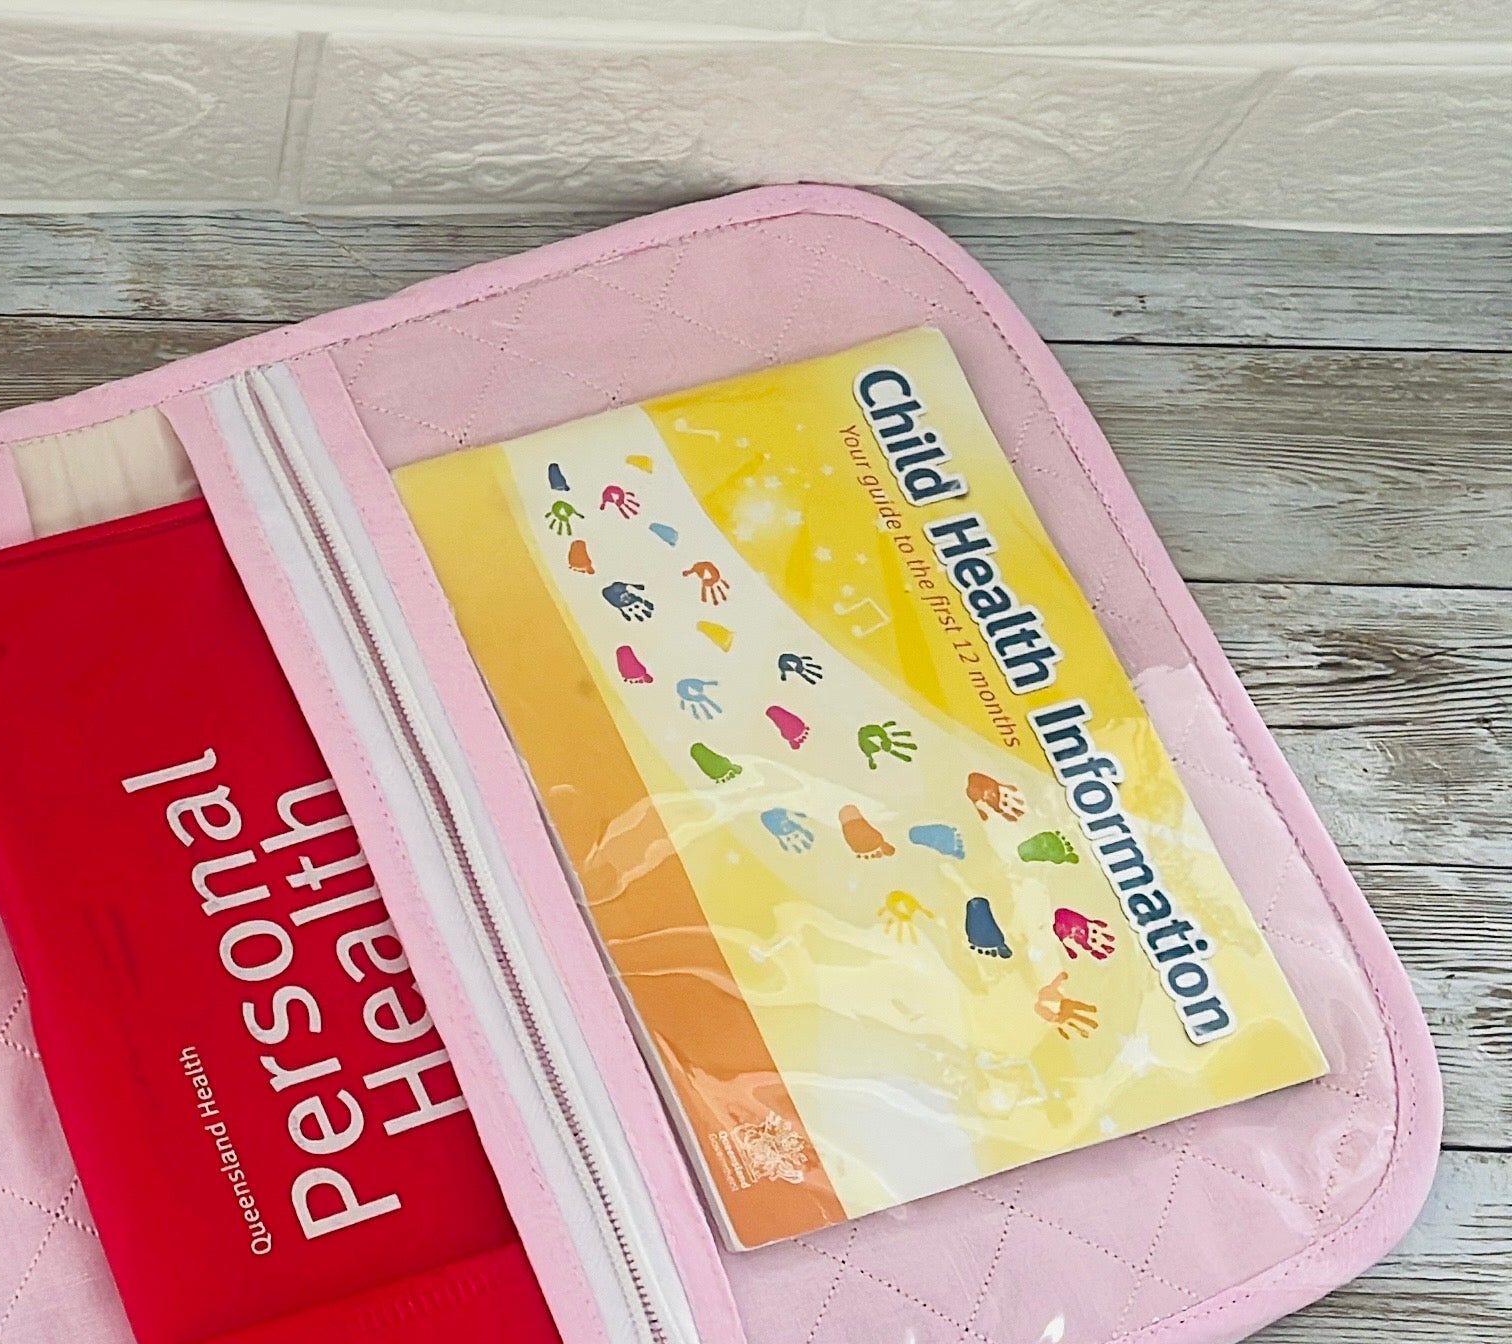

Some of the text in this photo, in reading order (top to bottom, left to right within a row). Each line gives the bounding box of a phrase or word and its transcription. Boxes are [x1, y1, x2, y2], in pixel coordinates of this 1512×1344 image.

[839, 424, 1022, 748] Your guide to the first 12 months
[859, 368, 1230, 1034] Child Health Information
[121, 746, 403, 1241] Personal
[259, 777, 470, 1137] Health
[178, 1045, 273, 1256] Queensland Health
